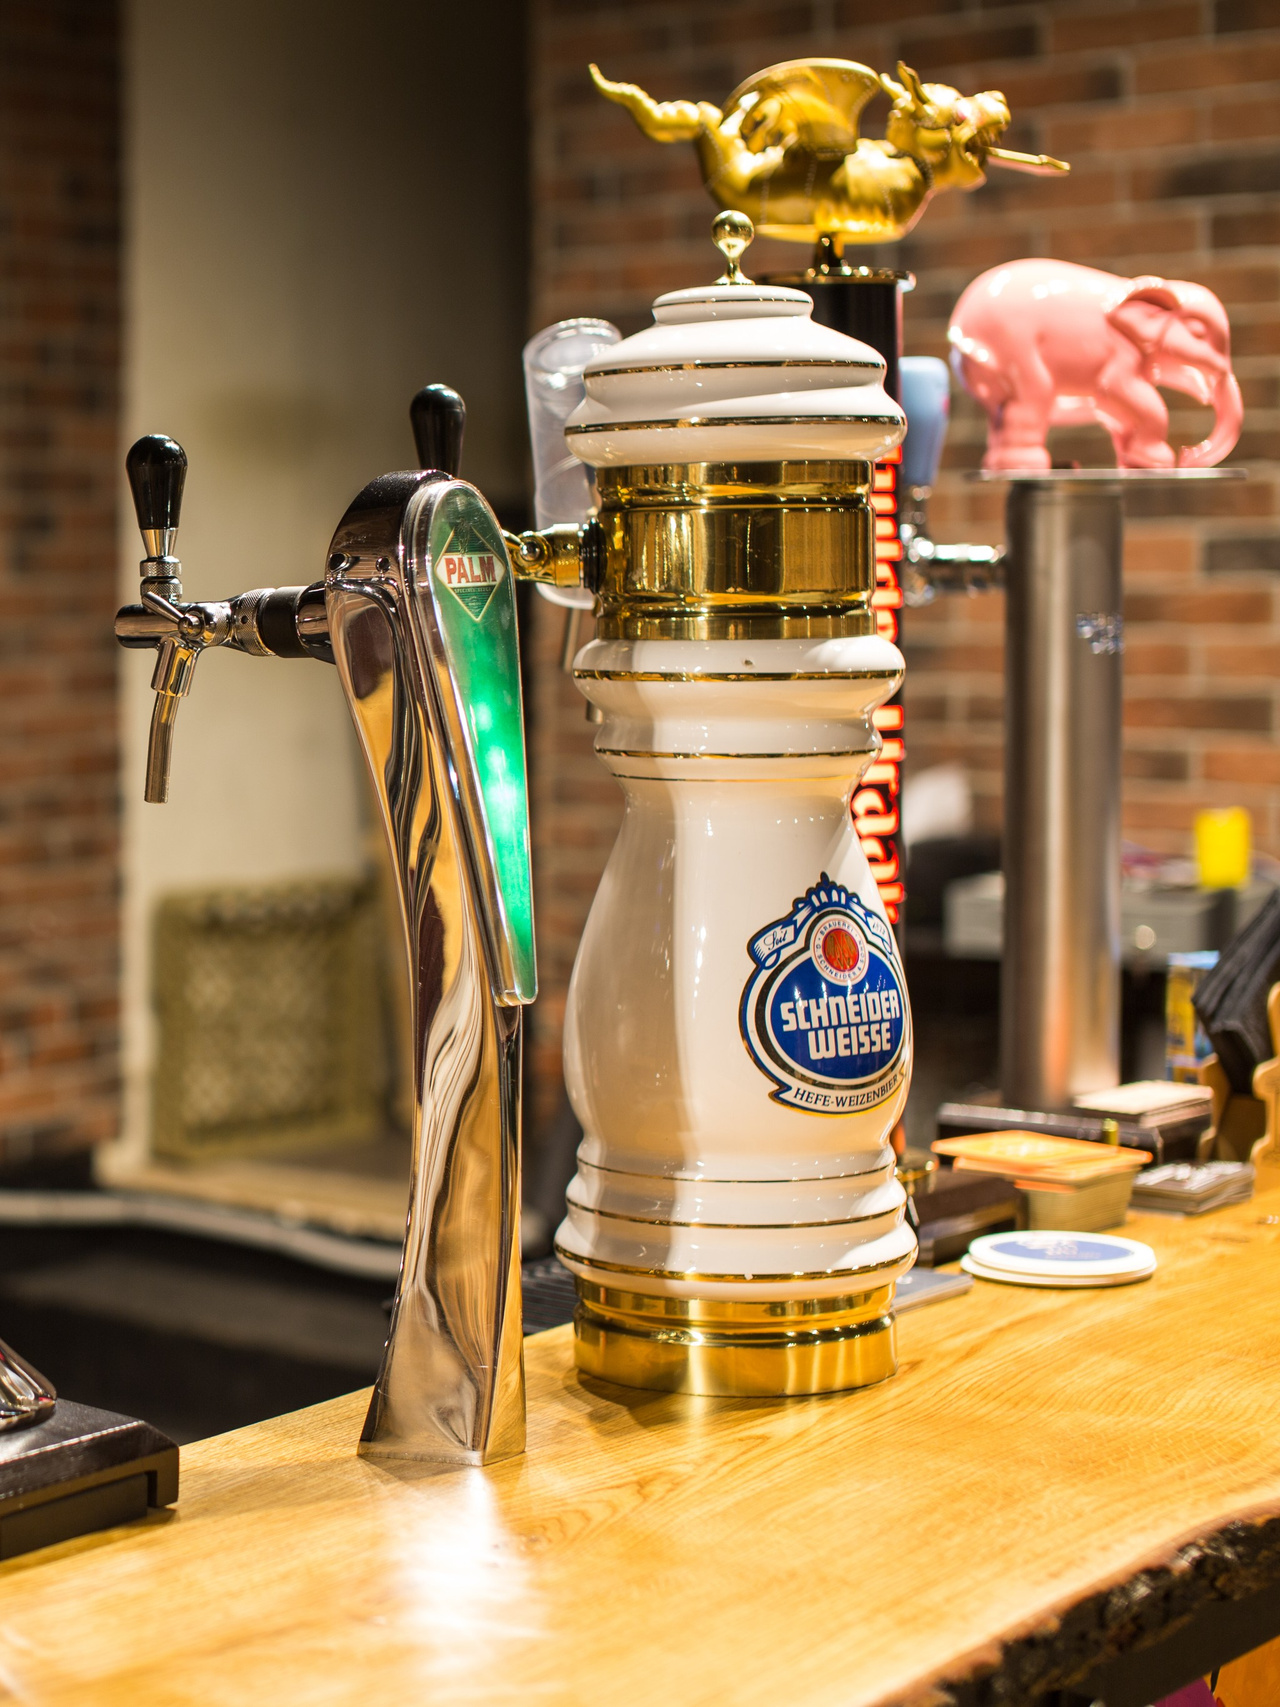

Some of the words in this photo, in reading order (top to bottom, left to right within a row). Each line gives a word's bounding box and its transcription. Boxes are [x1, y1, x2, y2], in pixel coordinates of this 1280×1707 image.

[445, 556, 497, 584] PALM
[780, 989, 900, 1032] SCHNEIDER
[808, 1022, 891, 1060] WEISSE
[794, 1074, 898, 1107] HEFE-WEIZENBIER
